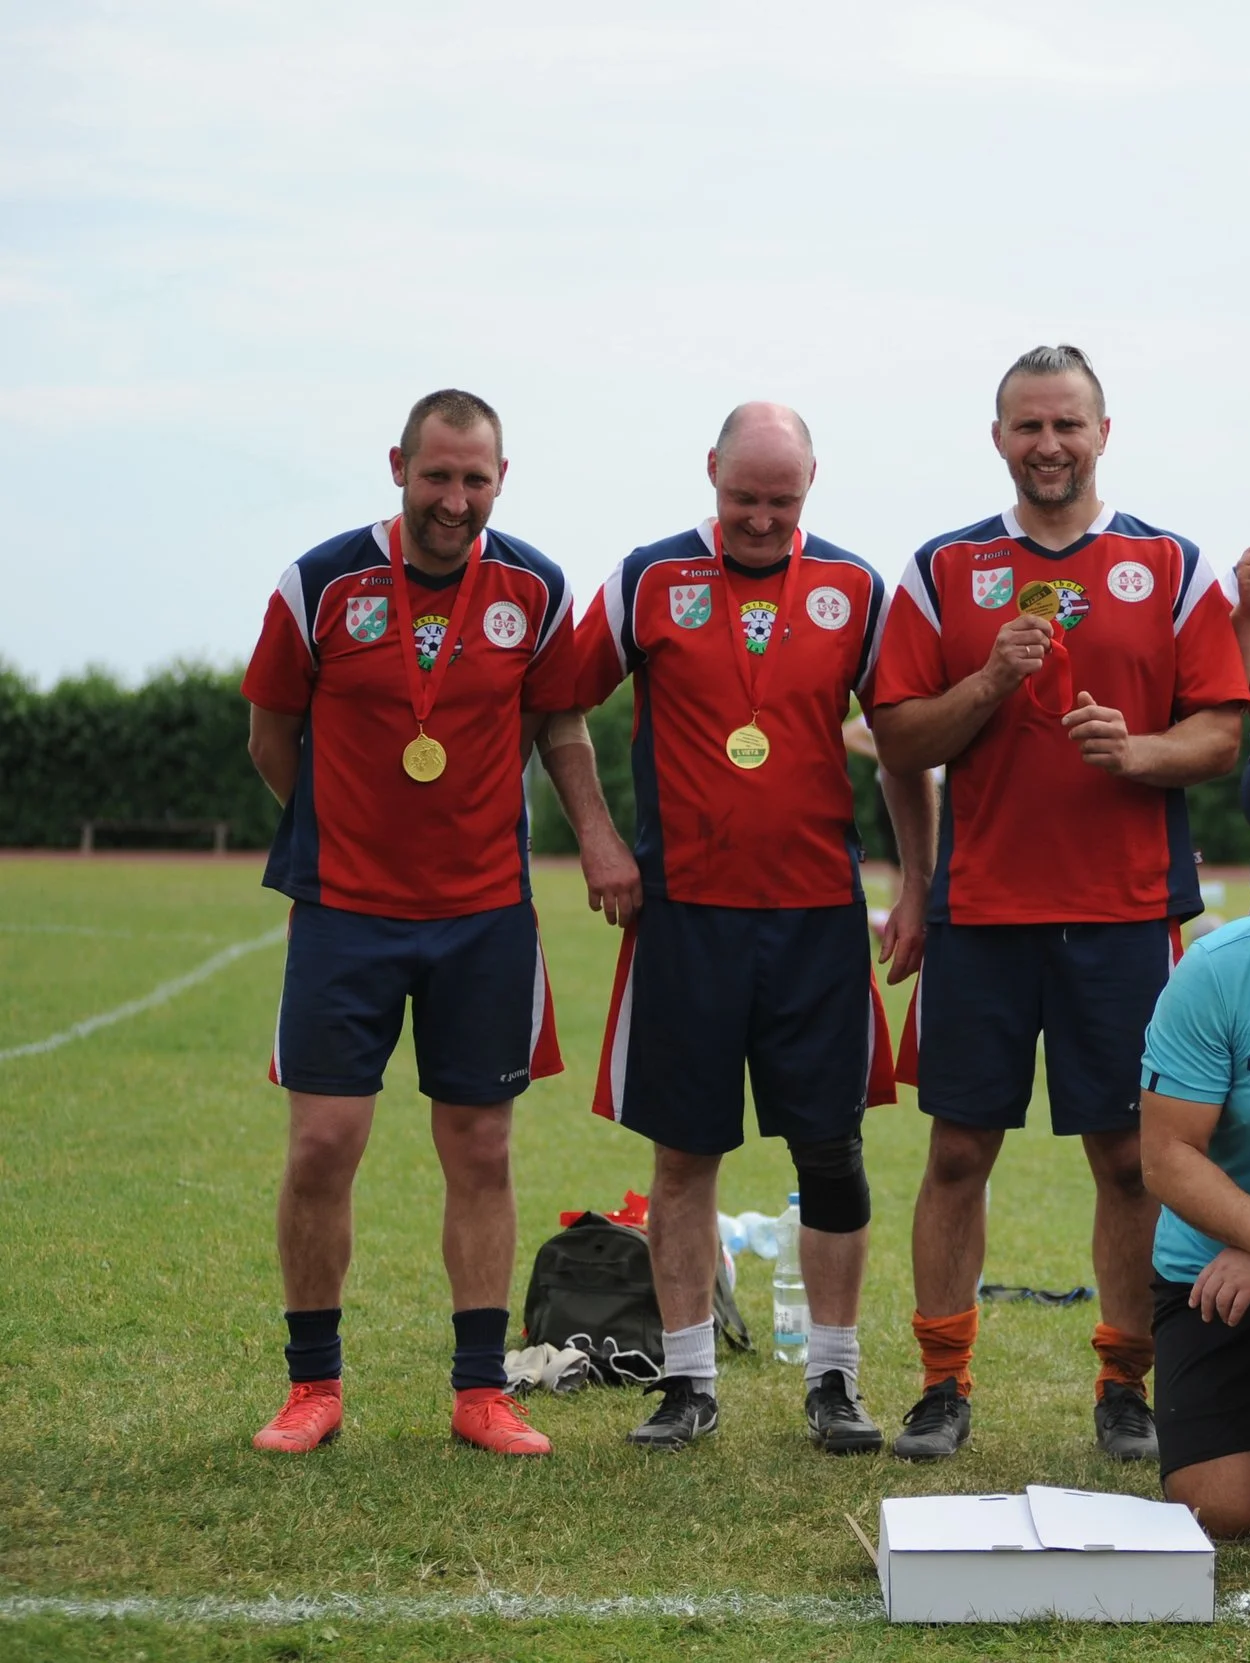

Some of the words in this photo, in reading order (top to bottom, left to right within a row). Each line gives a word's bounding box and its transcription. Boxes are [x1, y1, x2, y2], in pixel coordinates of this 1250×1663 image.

[688, 569, 720, 578] Joma
[369, 576, 393, 586] Jom
[1119, 577, 1142, 586] LSVS
[741, 601, 777, 612] utbol
[817, 603, 840, 613] LSVS
[750, 611, 769, 620] VK
[414, 615, 446, 627] Futbo
[493, 620, 515, 630] LSVS
[424, 625, 443, 635] VK
